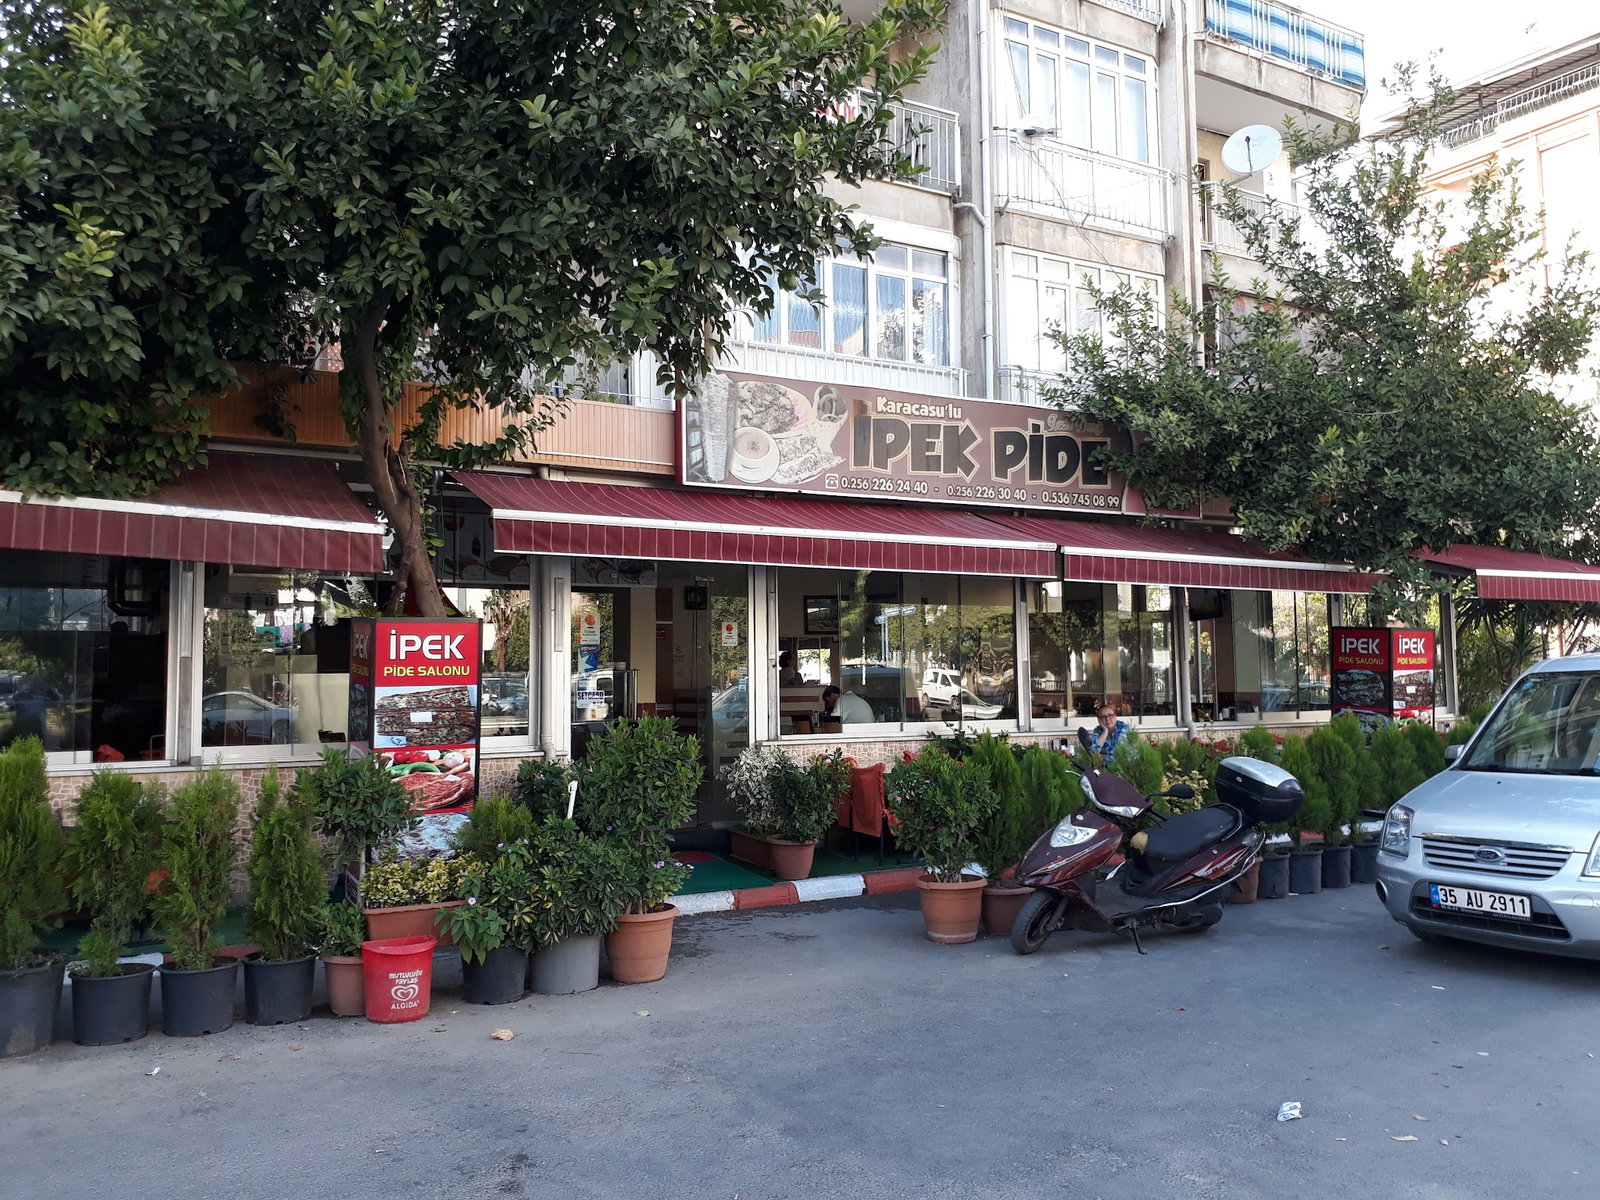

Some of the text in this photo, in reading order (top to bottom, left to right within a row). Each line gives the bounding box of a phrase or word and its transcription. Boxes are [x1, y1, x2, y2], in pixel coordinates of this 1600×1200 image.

[876, 396, 962, 419] Karacasu'lu
[849, 399, 1111, 489] İPEK PİDE
[841, 476, 869, 490] 0.256
[872, 478, 894, 492] 226
[896, 479, 911, 493] 24
[913, 481, 928, 495] 40
[947, 485, 973, 498] 0.256
[975, 486, 995, 500] 226
[998, 487, 1011, 500] 30
[1013, 488, 1027, 501] 40
[1042, 491, 1070, 504] 0.536
[1072, 493, 1090, 506] 745
[1092, 494, 1105, 507] 08
[1107, 495, 1120, 508] 99
[389, 629, 466, 660] İPEK
[1341, 634, 1380, 655] İPEK
[1398, 634, 1425, 655] İPEK
[384, 664, 415, 678] PİDE
[417, 664, 470, 678] SALONU
[1355, 656, 1384, 666] SALONU
[1439, 887, 1458, 904] 35
[1466, 891, 1484, 908] AU
[1488, 894, 1526, 915] 2911
